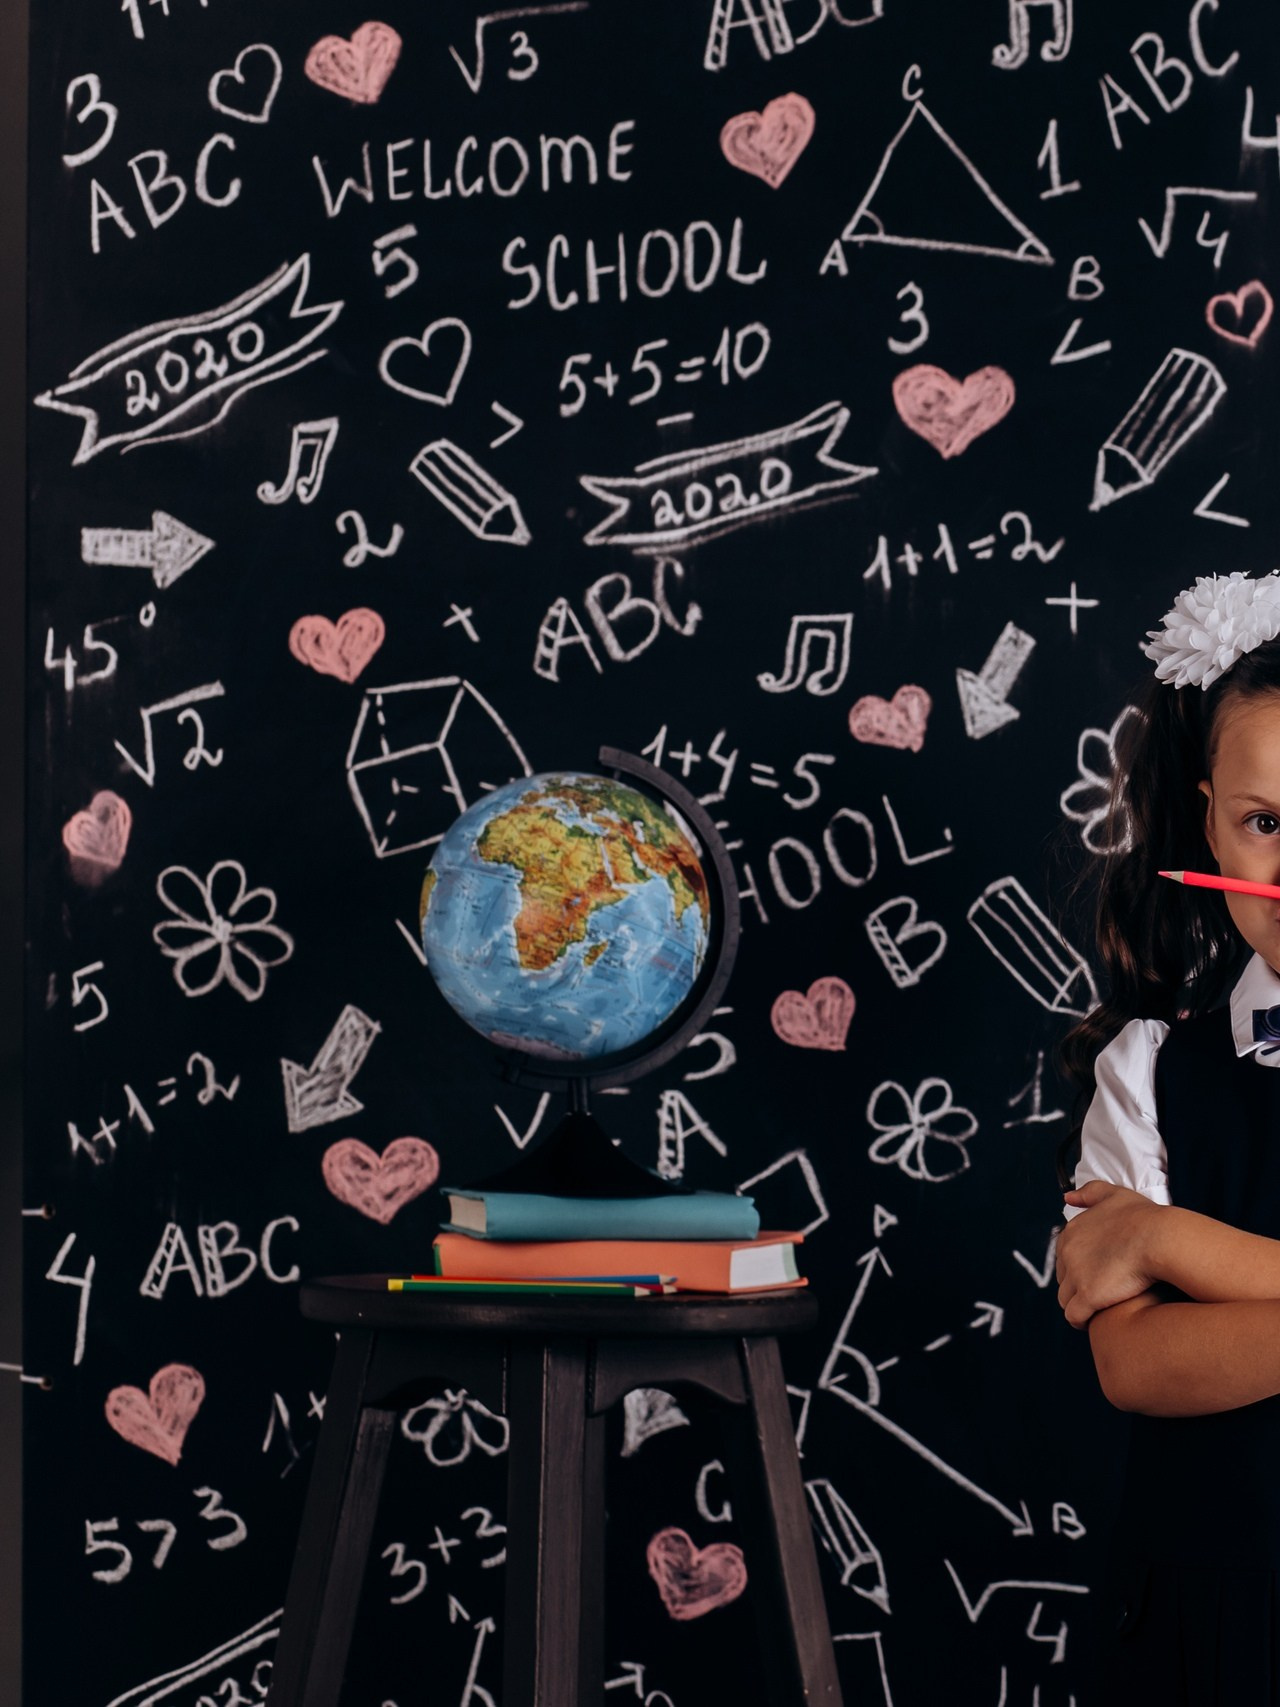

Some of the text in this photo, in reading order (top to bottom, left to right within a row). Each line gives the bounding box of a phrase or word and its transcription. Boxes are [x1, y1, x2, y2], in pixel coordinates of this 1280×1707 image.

[1101, 0, 1239, 150] ABC
[62, 73, 118, 168] 3
[1037, 119, 1080, 199] 1
[90, 133, 242, 254] ABC
[372, 224, 419, 298] 5
[502, 217, 767, 311] SCHOOL
[888, 281, 929, 354] 3
[124, 320, 267, 418] 2020
[652, 458, 793, 528] 2020
[335, 510, 404, 568] 2
[533, 556, 702, 682] ABC
[72, 961, 109, 1032] 5
[45, 1232, 96, 1365] 4
[139, 1216, 300, 1299] ABC
